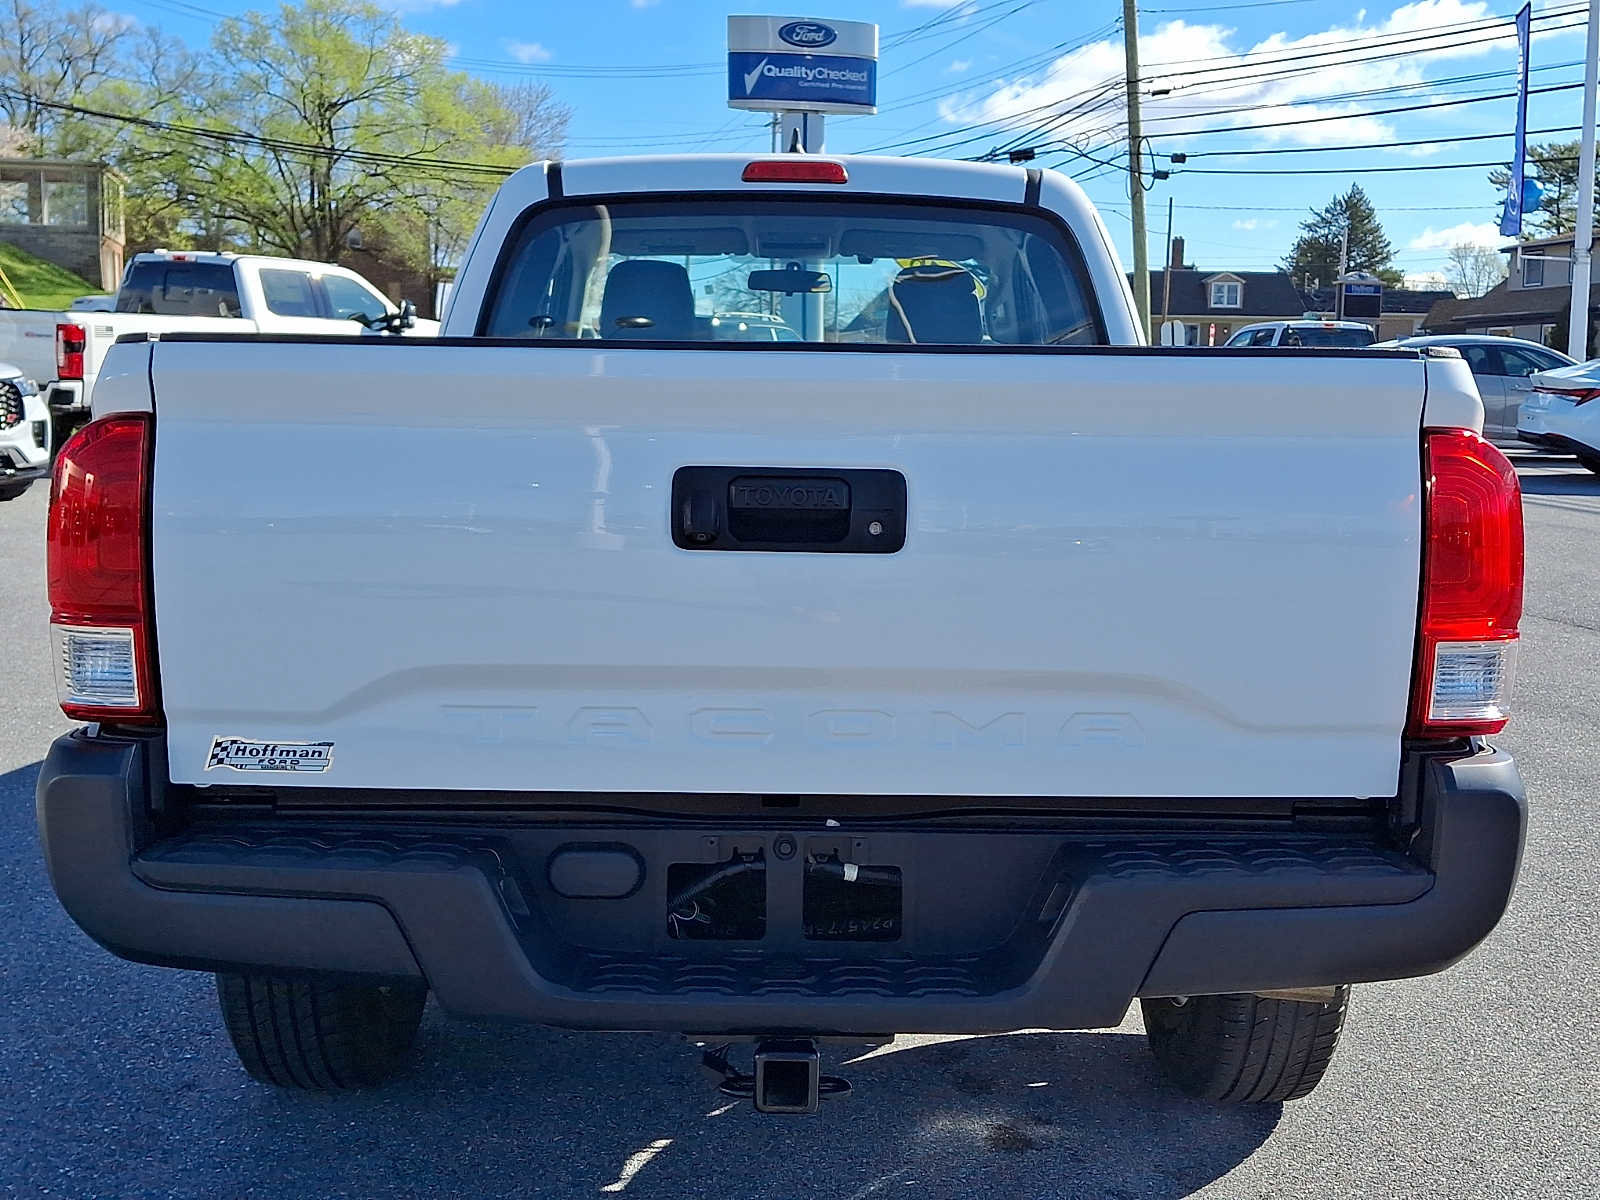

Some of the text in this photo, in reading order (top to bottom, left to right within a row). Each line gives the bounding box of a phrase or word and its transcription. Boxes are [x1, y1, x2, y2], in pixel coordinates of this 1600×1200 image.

[792, 25, 825, 41] Ford
[738, 487, 840, 506] TOYOTA
[439, 704, 1147, 748] TACOMA
[234, 745, 323, 758] Hoffman
[258, 758, 301, 766] FORD
